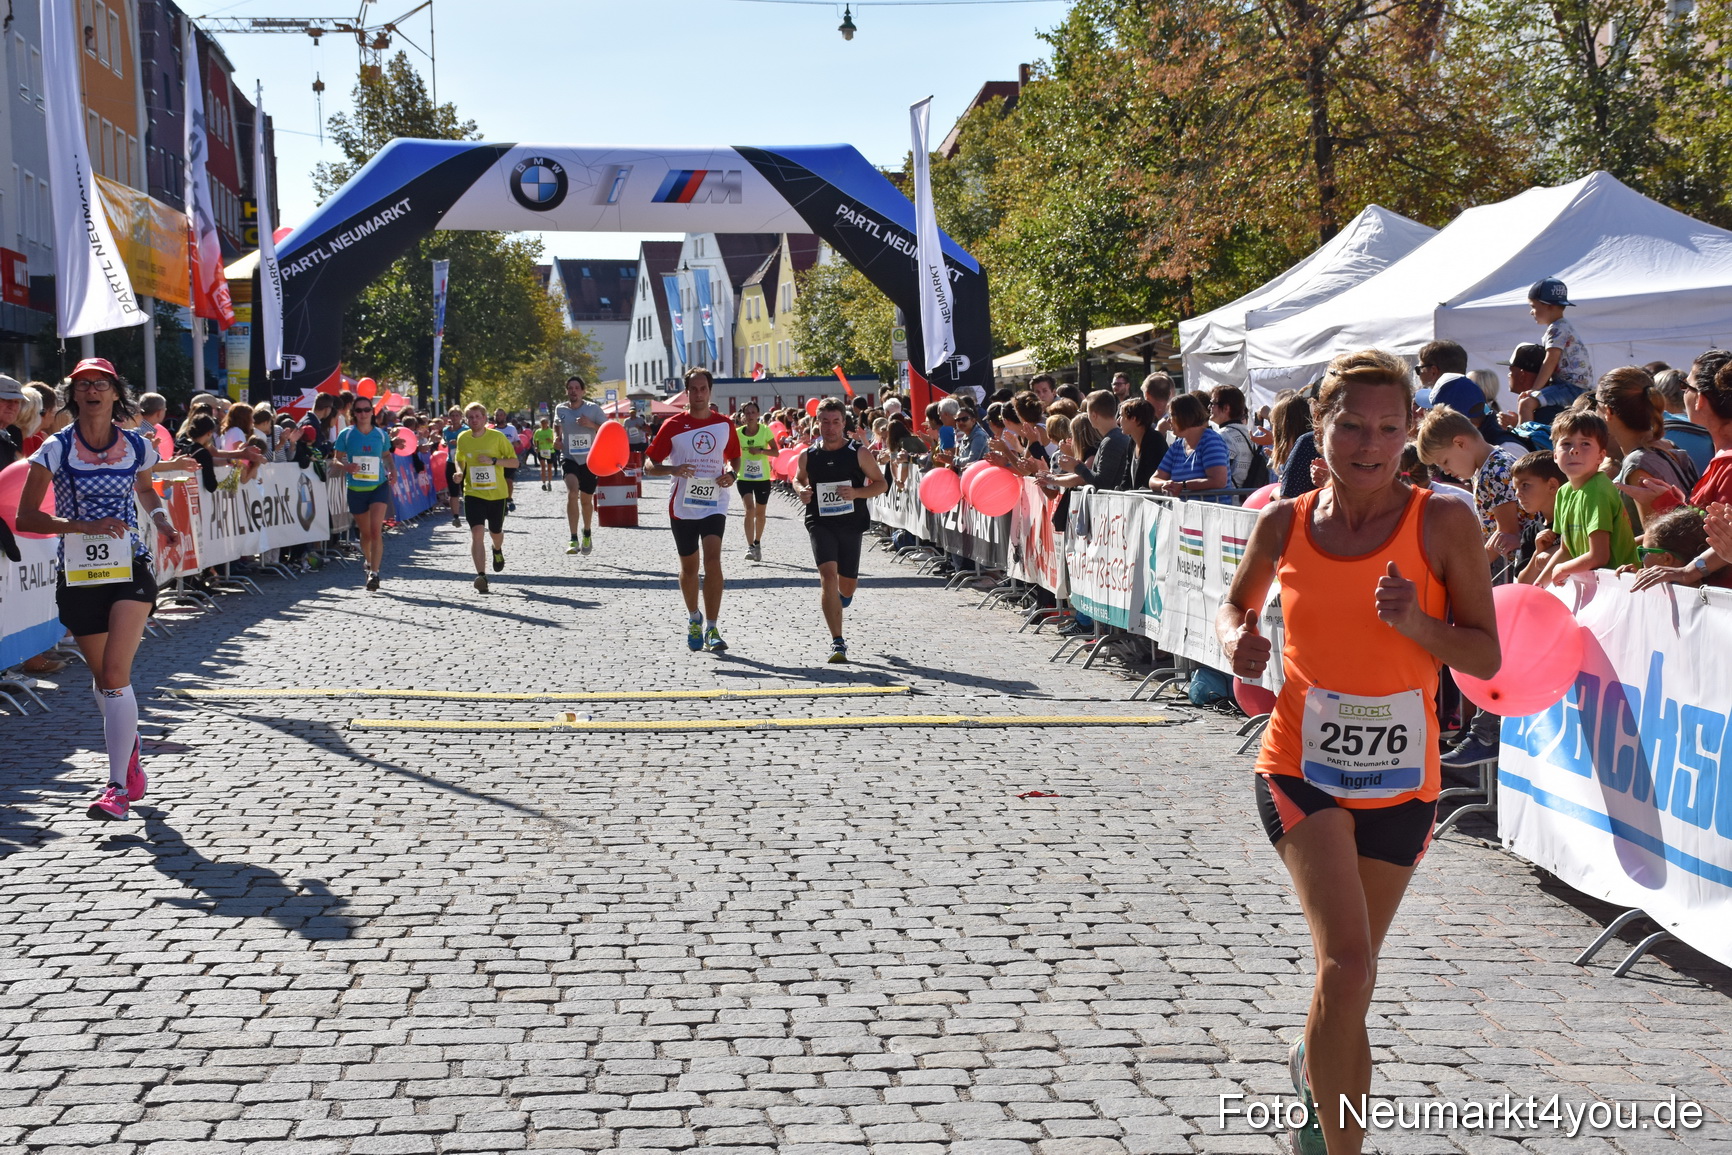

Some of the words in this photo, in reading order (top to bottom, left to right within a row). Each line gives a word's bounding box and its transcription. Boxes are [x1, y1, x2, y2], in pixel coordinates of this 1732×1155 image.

[280, 246, 331, 281] PARTL
[329, 197, 412, 254] NEUMARKT
[835, 204, 880, 238] PARTL
[883, 231, 964, 283] NEUKT
[929, 264, 951, 324] NEUMARKT
[475, 472, 490, 480] 293
[690, 484, 714, 496] 2637
[822, 491, 842, 503] 202
[210, 490, 246, 541] PARTL
[85, 543, 110, 562] 93
[87, 571, 110, 580] Beate
[1338, 703, 1393, 718] BOCK
[1319, 721, 1408, 756] 2576
[1326, 756, 1352, 767] PARTL
[1353, 760, 1389, 768] Neumarkt
[1340, 772, 1383, 789] Ingrid
